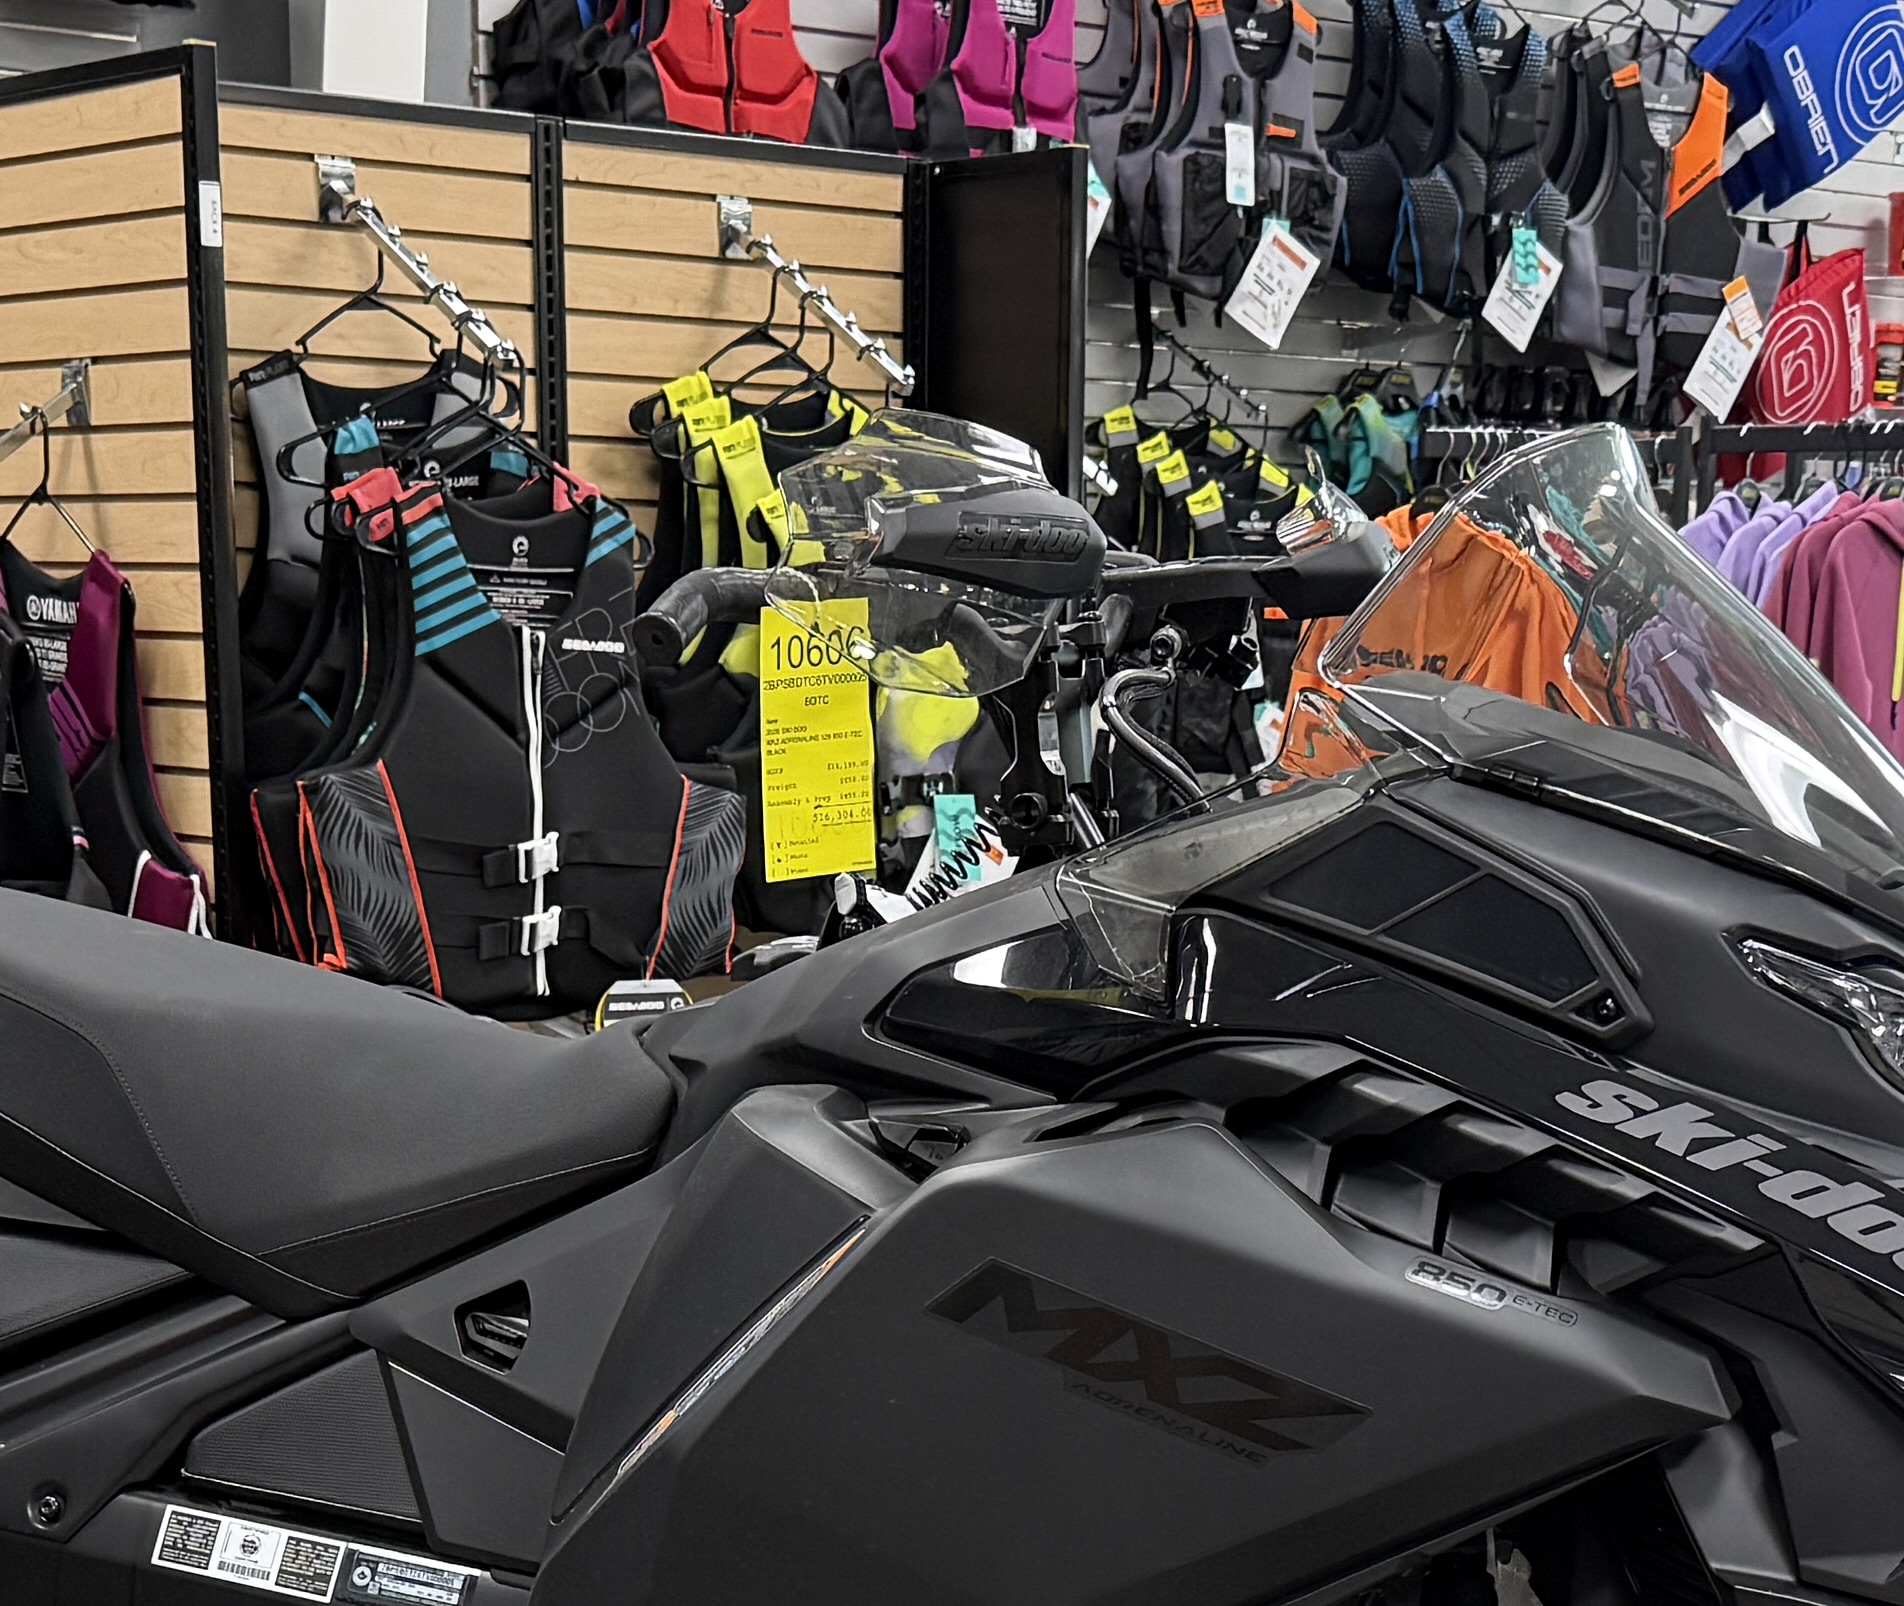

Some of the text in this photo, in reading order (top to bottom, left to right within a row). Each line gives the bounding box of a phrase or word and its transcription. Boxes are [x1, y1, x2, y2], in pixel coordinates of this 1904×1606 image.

[1410, 1260, 1575, 1325] 850 E-TEC
[931, 1264, 1370, 1452] MXZ
[1070, 1382, 1268, 1465] ADRENALINE
